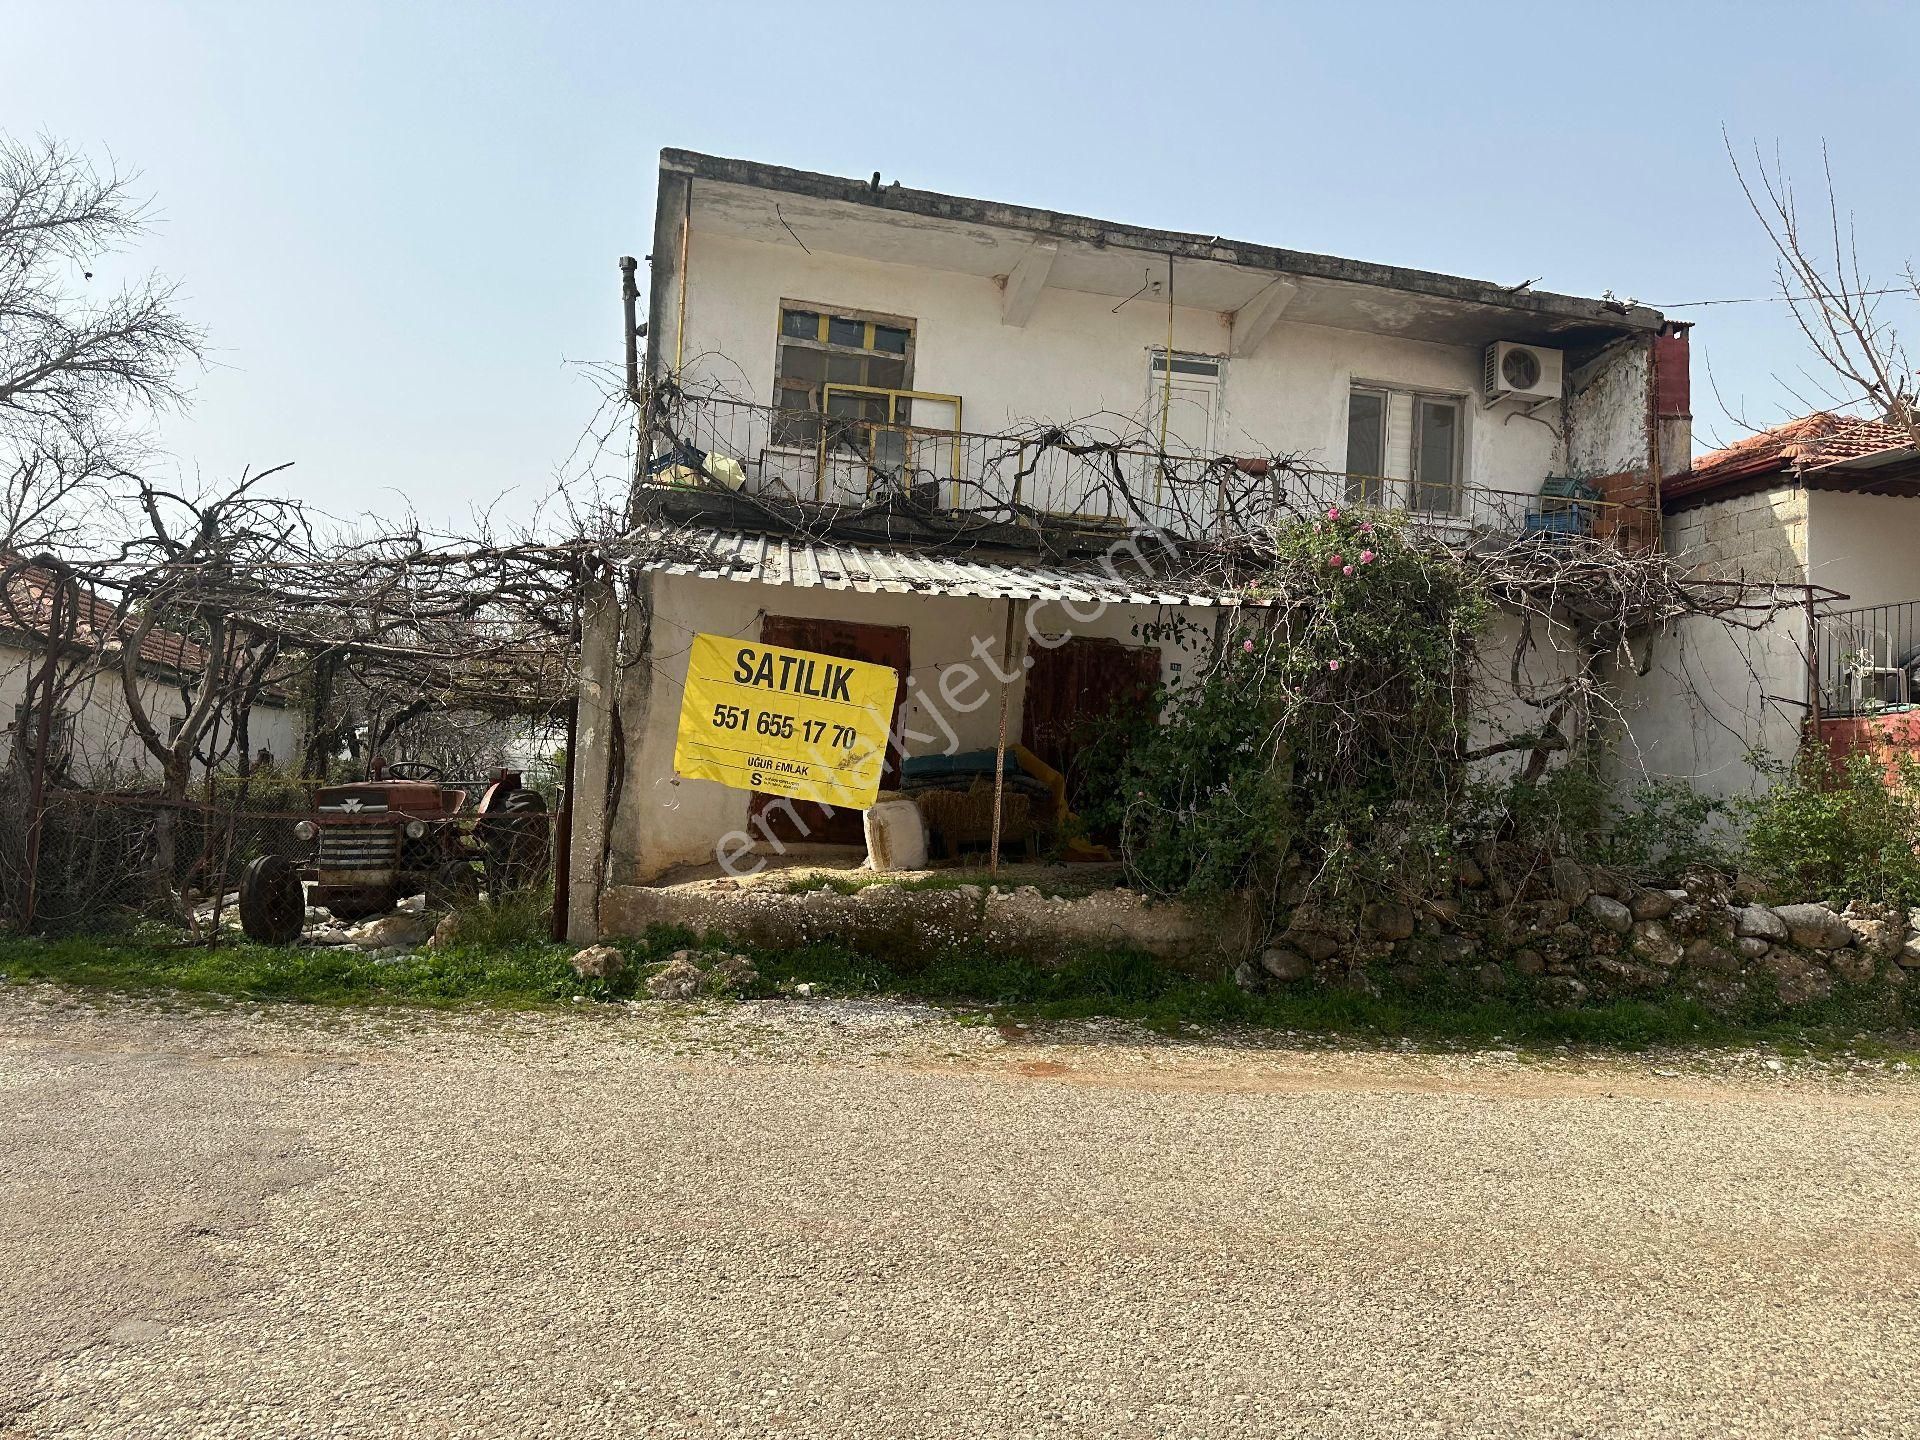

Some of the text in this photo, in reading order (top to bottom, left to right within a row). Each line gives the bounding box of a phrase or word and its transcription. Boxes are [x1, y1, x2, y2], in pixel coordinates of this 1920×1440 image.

[733, 648, 855, 702] SATILIK
[712, 703, 857, 750] 551 655 17 70
[747, 756, 809, 776] UĞUR EMLAK
